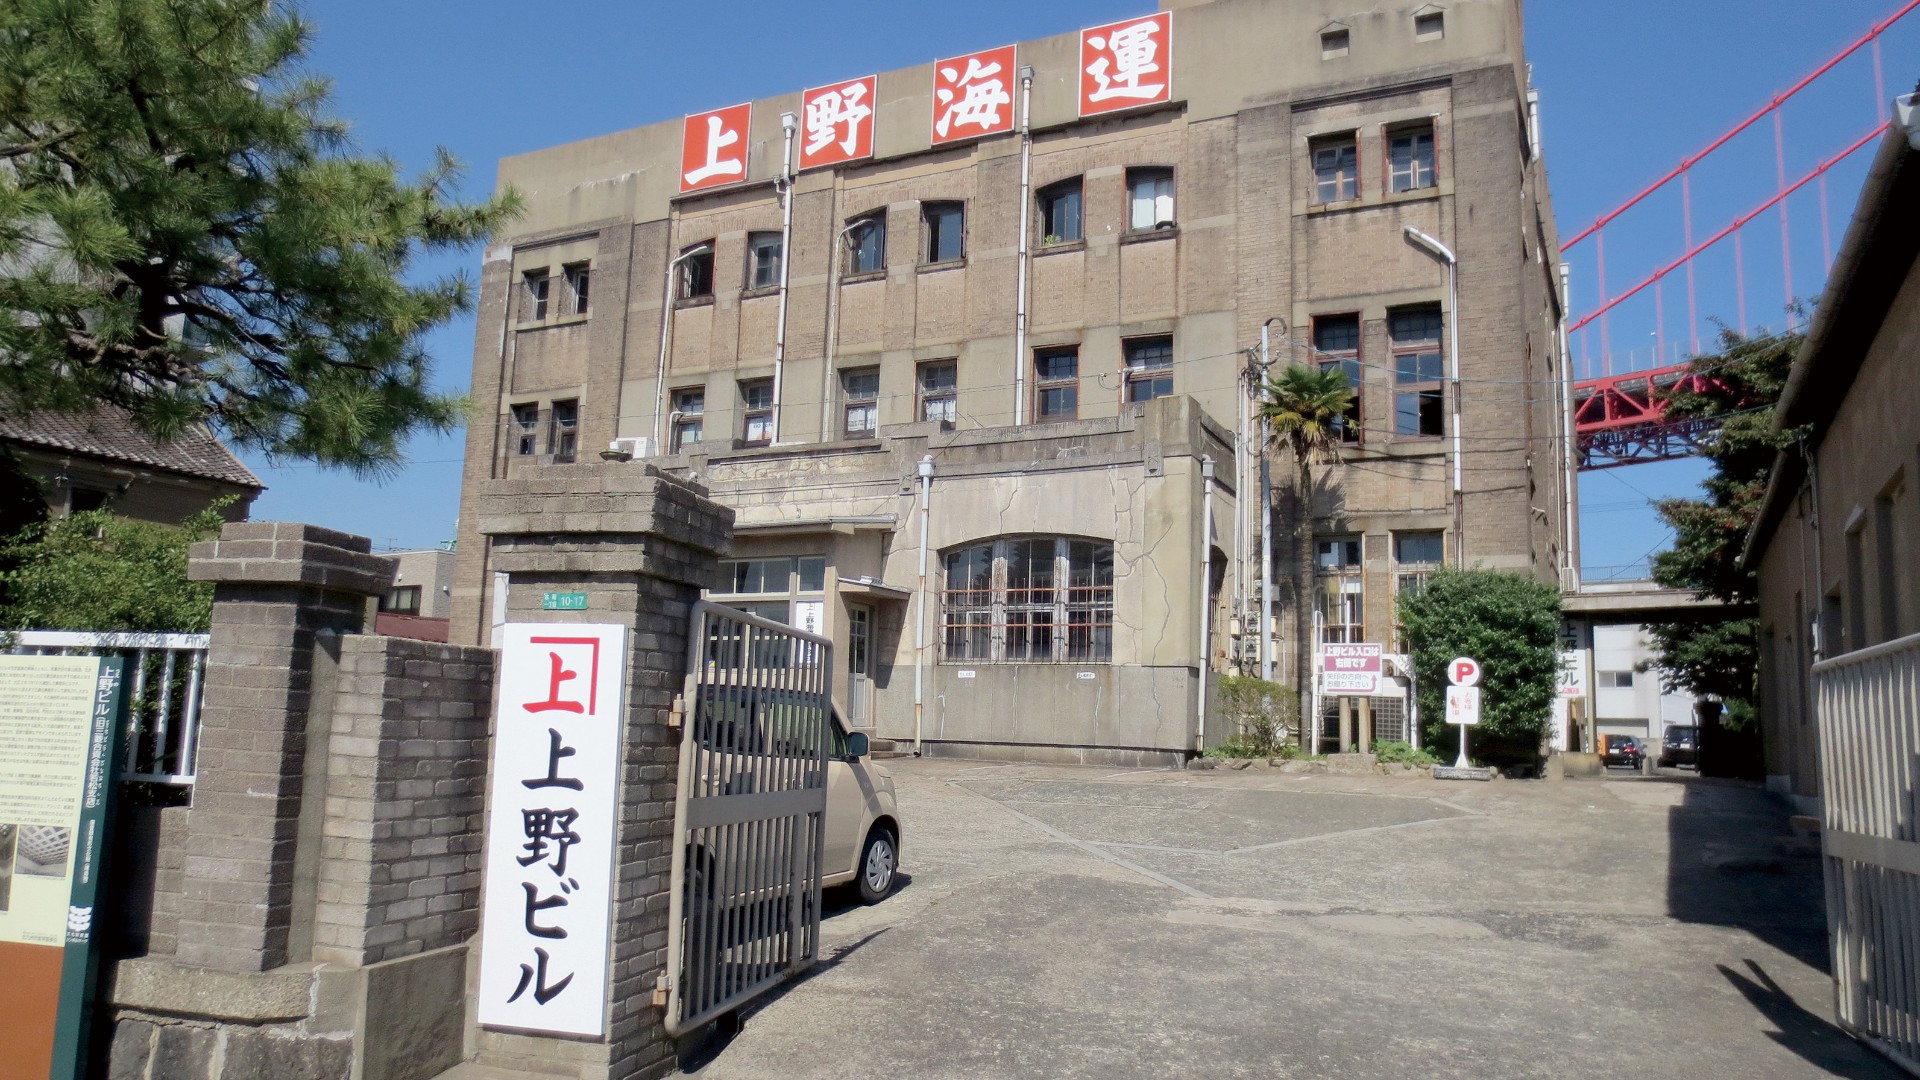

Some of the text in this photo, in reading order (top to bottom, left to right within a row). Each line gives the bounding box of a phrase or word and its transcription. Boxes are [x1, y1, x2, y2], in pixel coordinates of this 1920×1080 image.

[684, 20, 1166, 185] 上野海運
[561, 596, 584, 606] 10-17
[1325, 646, 1379, 657] 上野ビル入口は
[1456, 662, 1475, 682] P
[507, 727, 585, 1006] 上野ビル
